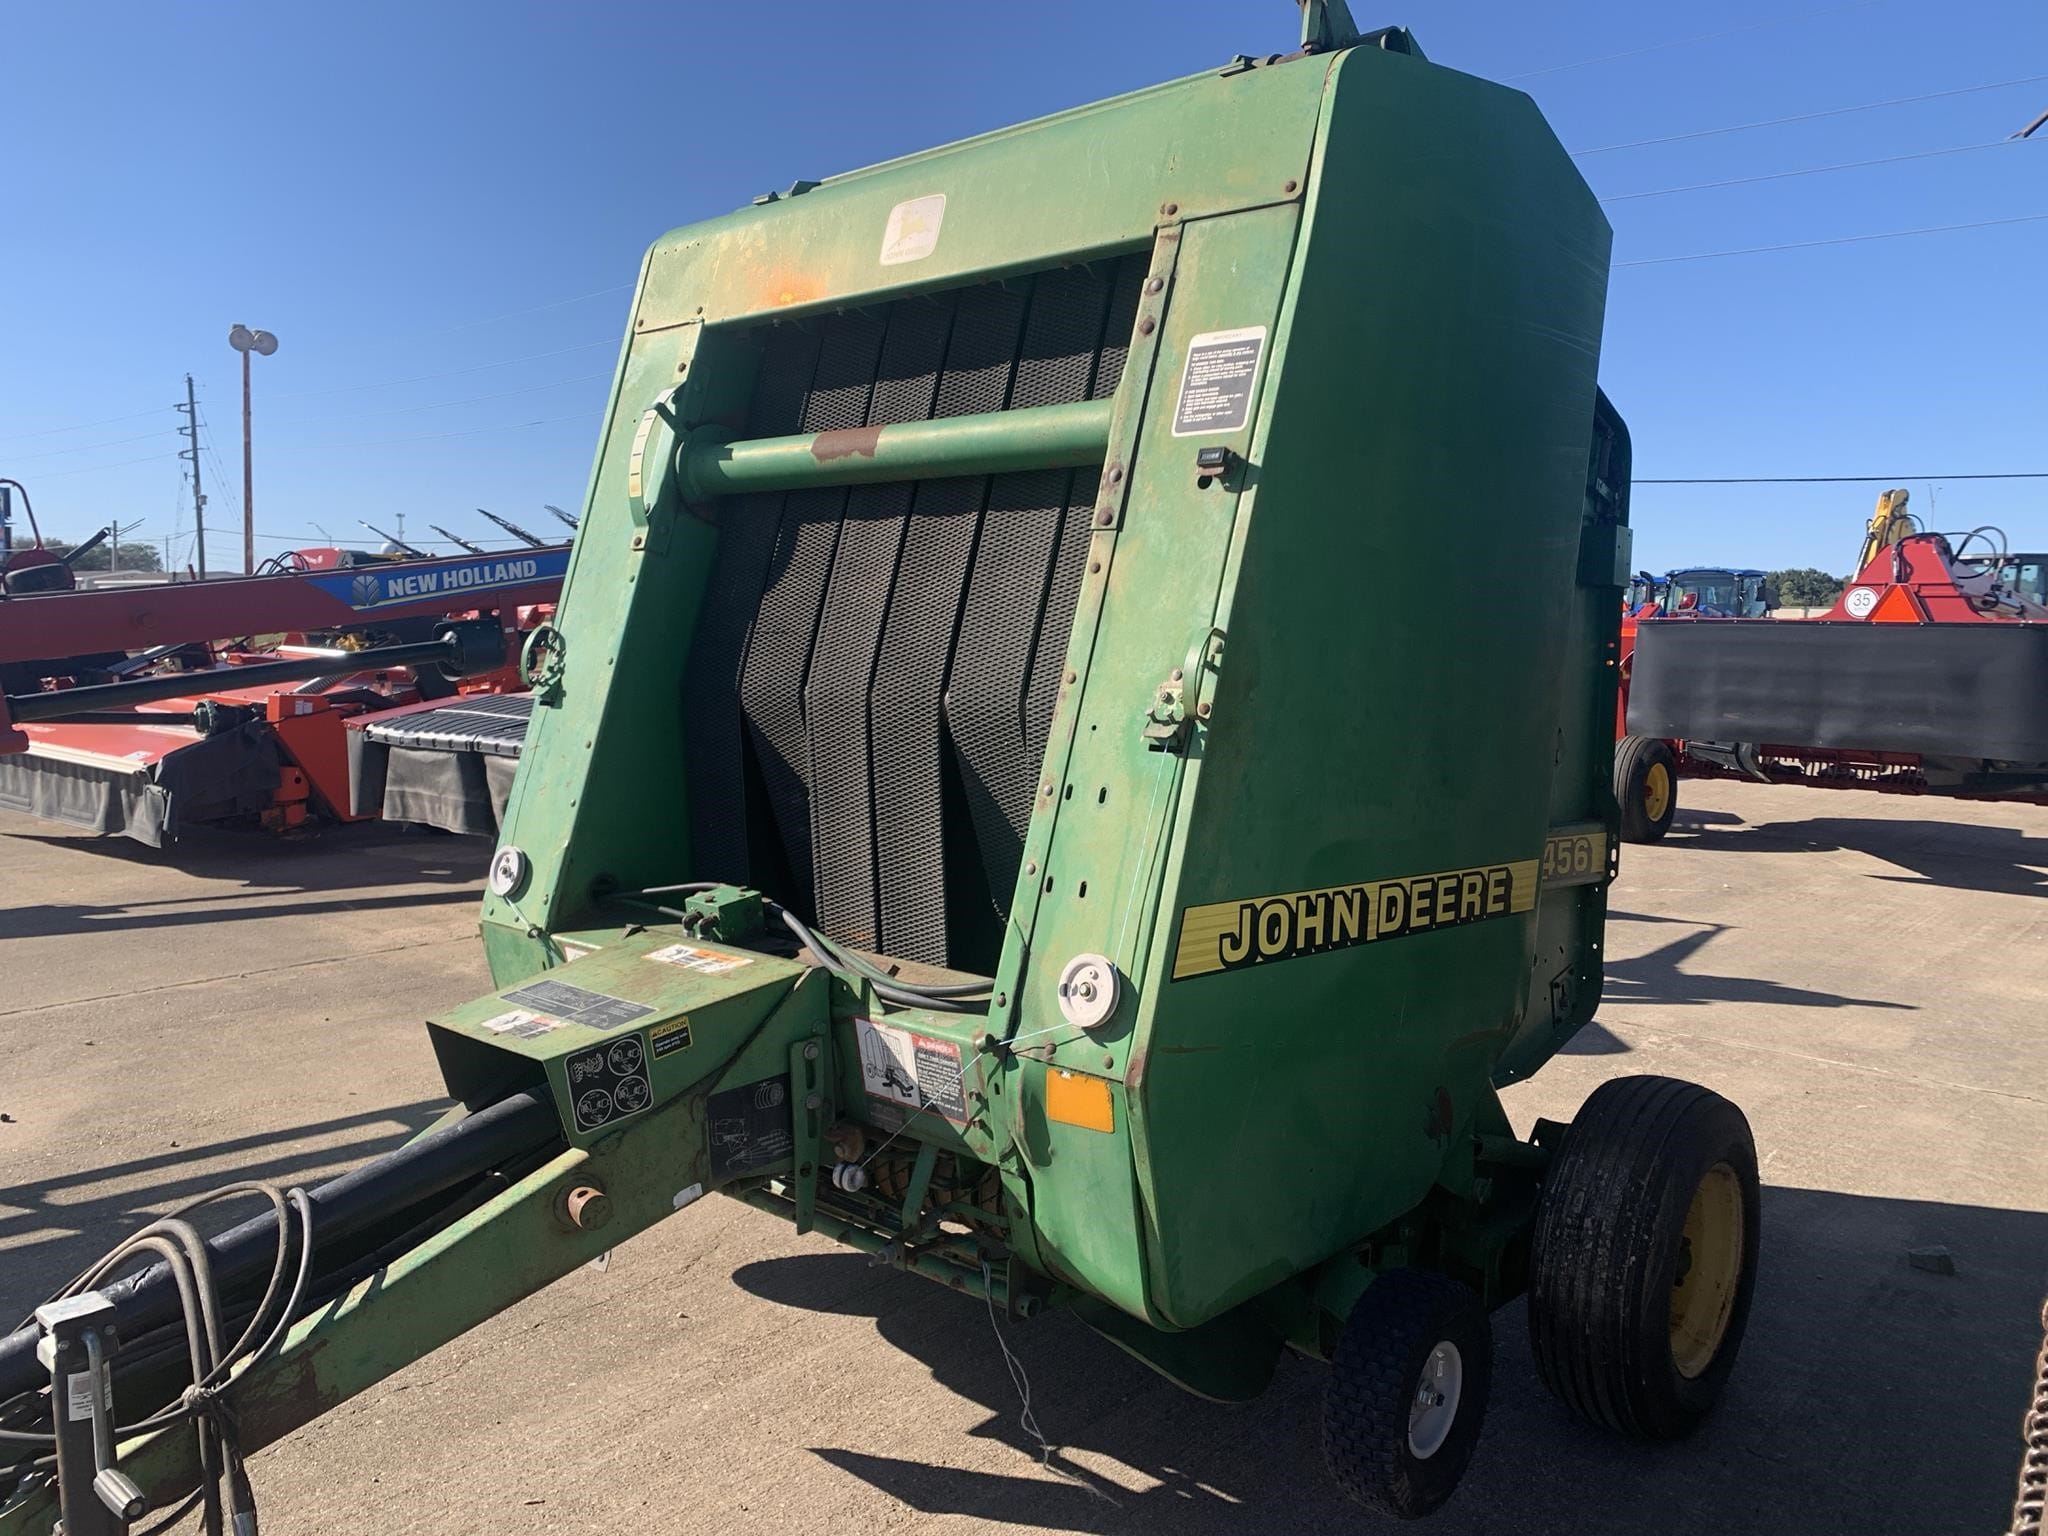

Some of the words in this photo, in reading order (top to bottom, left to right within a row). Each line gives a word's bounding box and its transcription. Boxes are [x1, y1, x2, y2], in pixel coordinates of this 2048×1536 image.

[388, 573, 438, 598] NEW
[442, 559, 537, 590] HOLLAND
[1853, 593, 1871, 607] 35
[1543, 838, 1590, 876] 456
[1220, 891, 1363, 965] JOHN
[1377, 869, 1513, 935] DEERE
[657, 1020, 687, 1036] CAUTION
